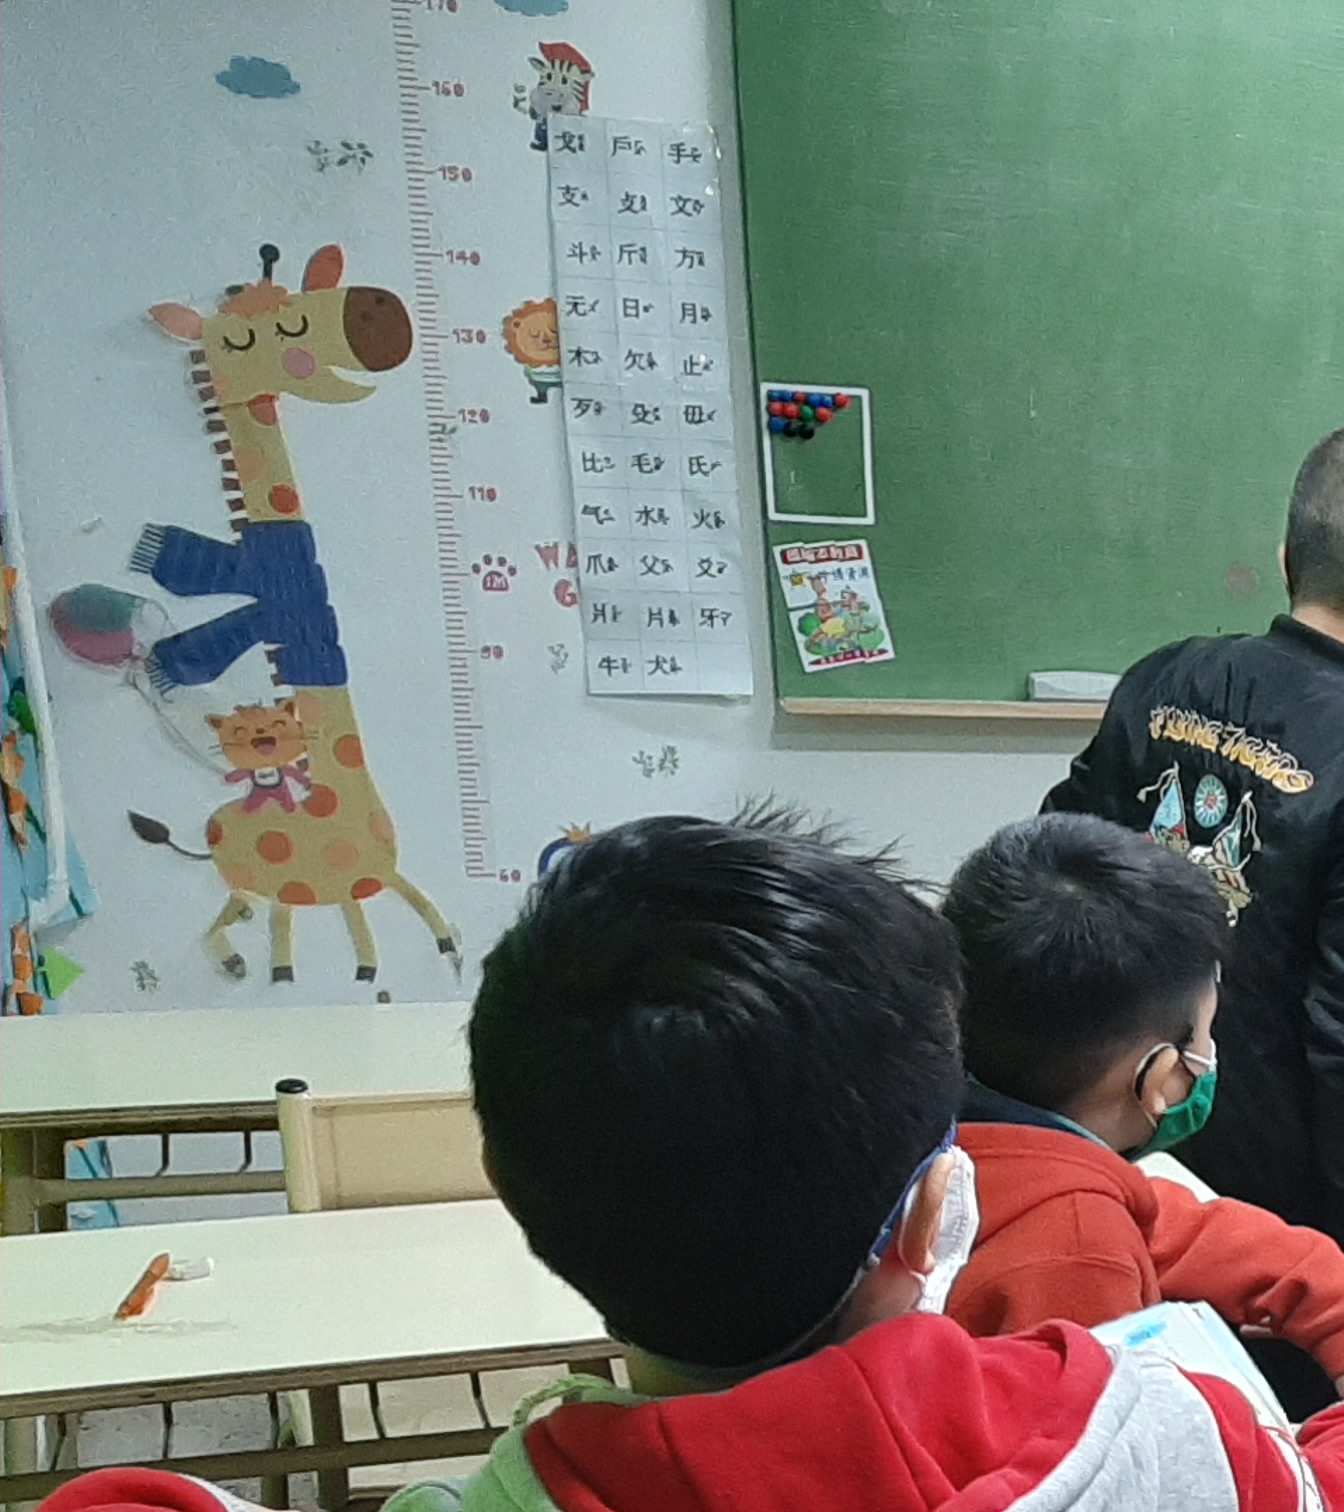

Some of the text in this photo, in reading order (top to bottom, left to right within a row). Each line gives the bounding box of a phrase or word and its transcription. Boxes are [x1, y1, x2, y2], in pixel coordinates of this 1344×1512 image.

[431, 80, 465, 97] 160
[439, 165, 473, 182] 150
[445, 250, 481, 266] 140
[623, 297, 640, 319] 日
[679, 302, 697, 324] 月
[452, 329, 486, 344] 130
[468, 486, 497, 502] 110
[480, 645, 504, 660] 90
